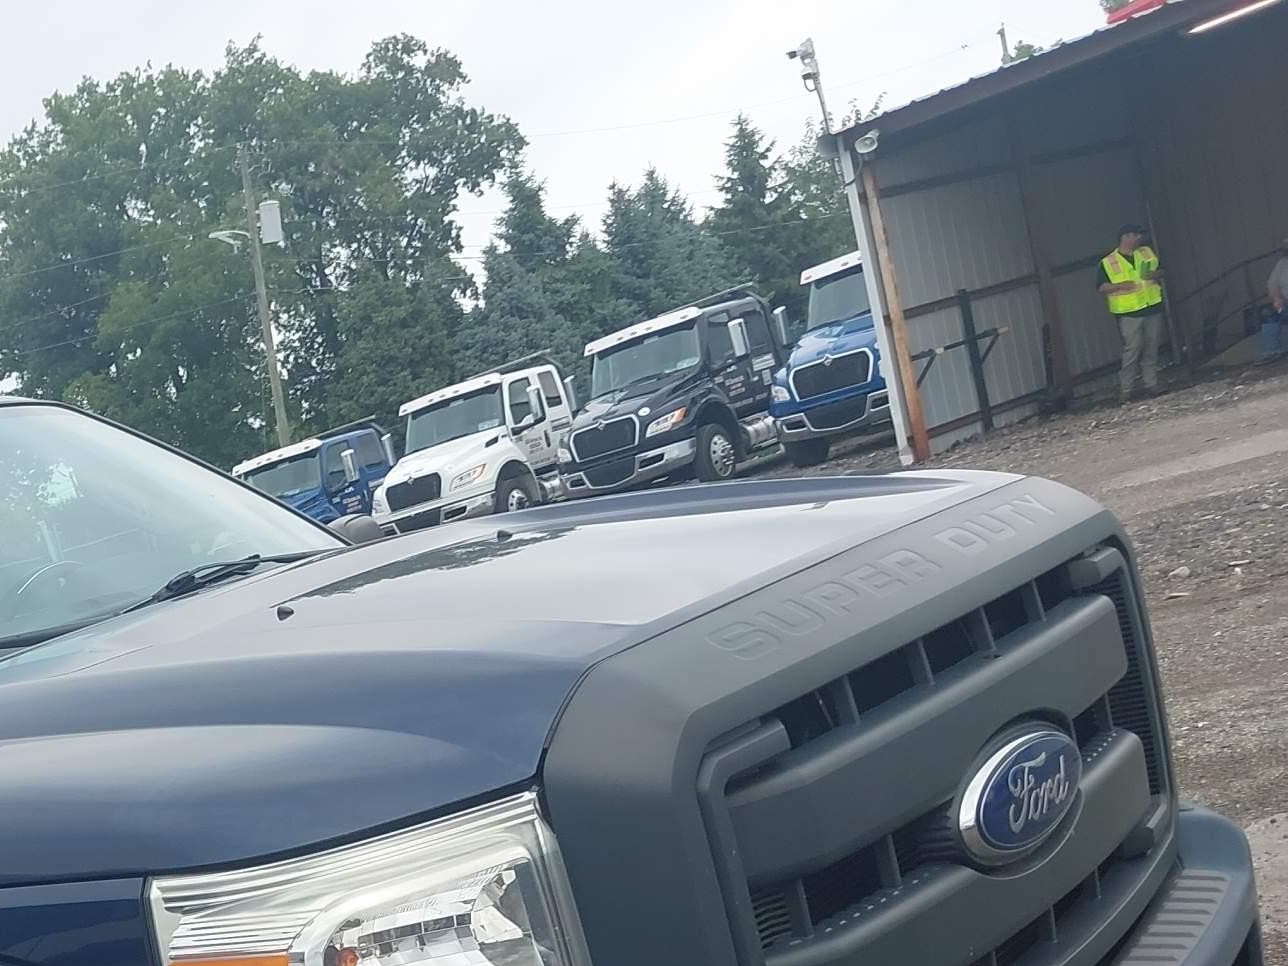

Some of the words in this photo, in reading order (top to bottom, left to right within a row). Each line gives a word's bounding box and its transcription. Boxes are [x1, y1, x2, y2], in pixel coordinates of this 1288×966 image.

[705, 548, 943, 661] SUPER
[933, 493, 1057, 556] DUTY
[1007, 751, 1070, 834] Ford
